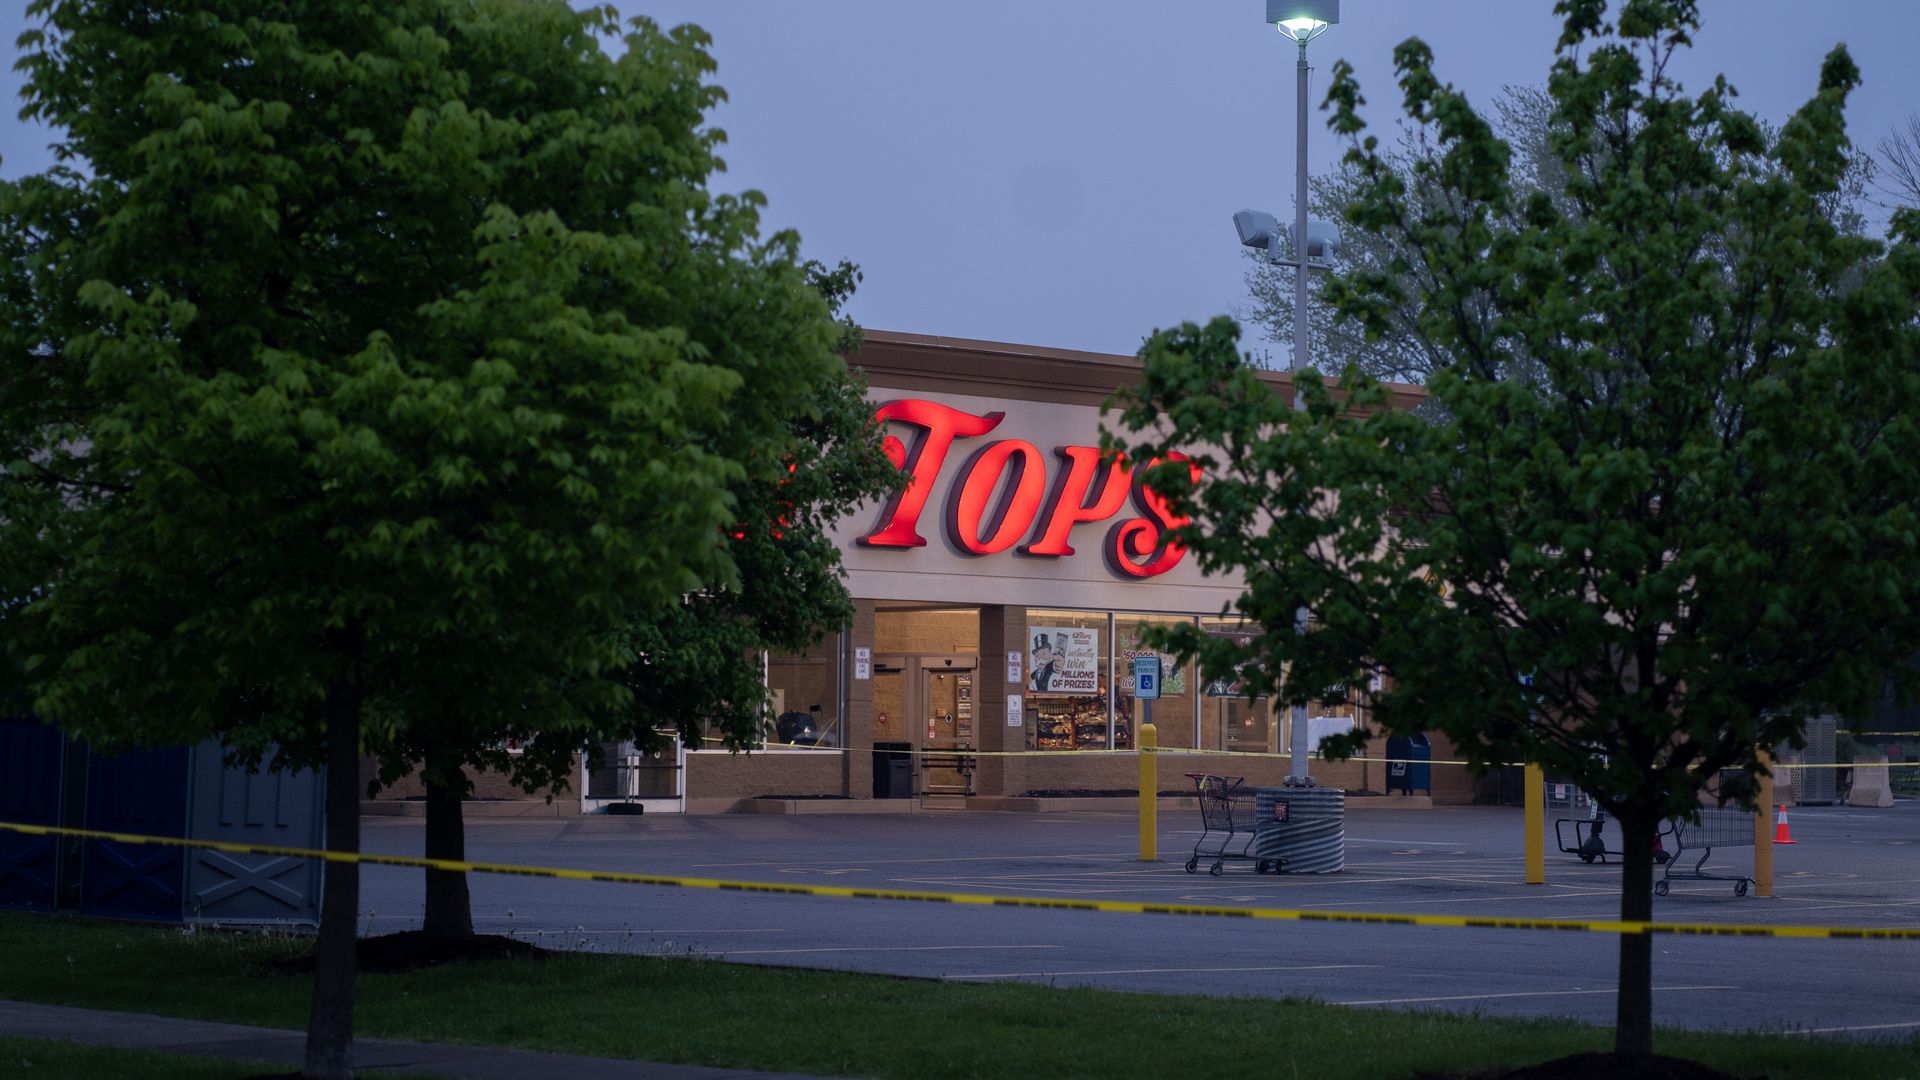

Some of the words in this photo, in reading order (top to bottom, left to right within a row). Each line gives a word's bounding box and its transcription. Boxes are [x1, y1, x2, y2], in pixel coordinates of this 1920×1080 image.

[1067, 648, 1095, 663] instantly
[1061, 670, 1095, 679] MILLIONS
[1052, 679, 1063, 688] OF
[1064, 679, 1095, 689] PRIZES!
